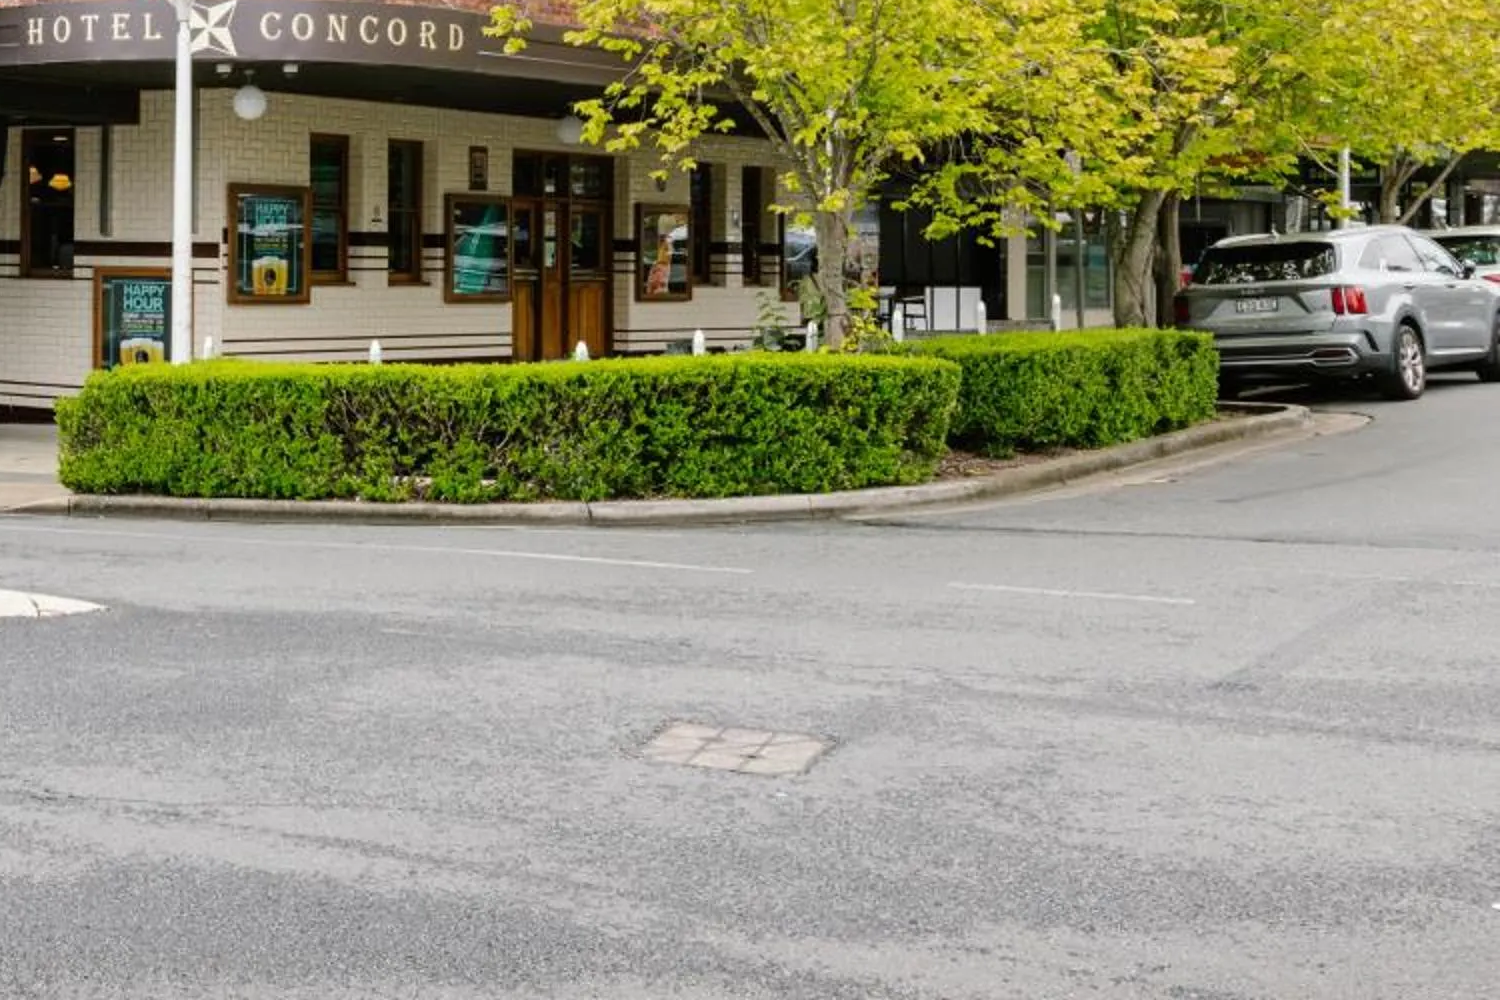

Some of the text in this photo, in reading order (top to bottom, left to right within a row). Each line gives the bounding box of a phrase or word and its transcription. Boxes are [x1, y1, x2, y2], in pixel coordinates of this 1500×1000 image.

[27, 11, 465, 51] HOTEL CONCORD
[123, 285, 165, 297] HAPPY
[123, 297, 164, 312] HOUR
